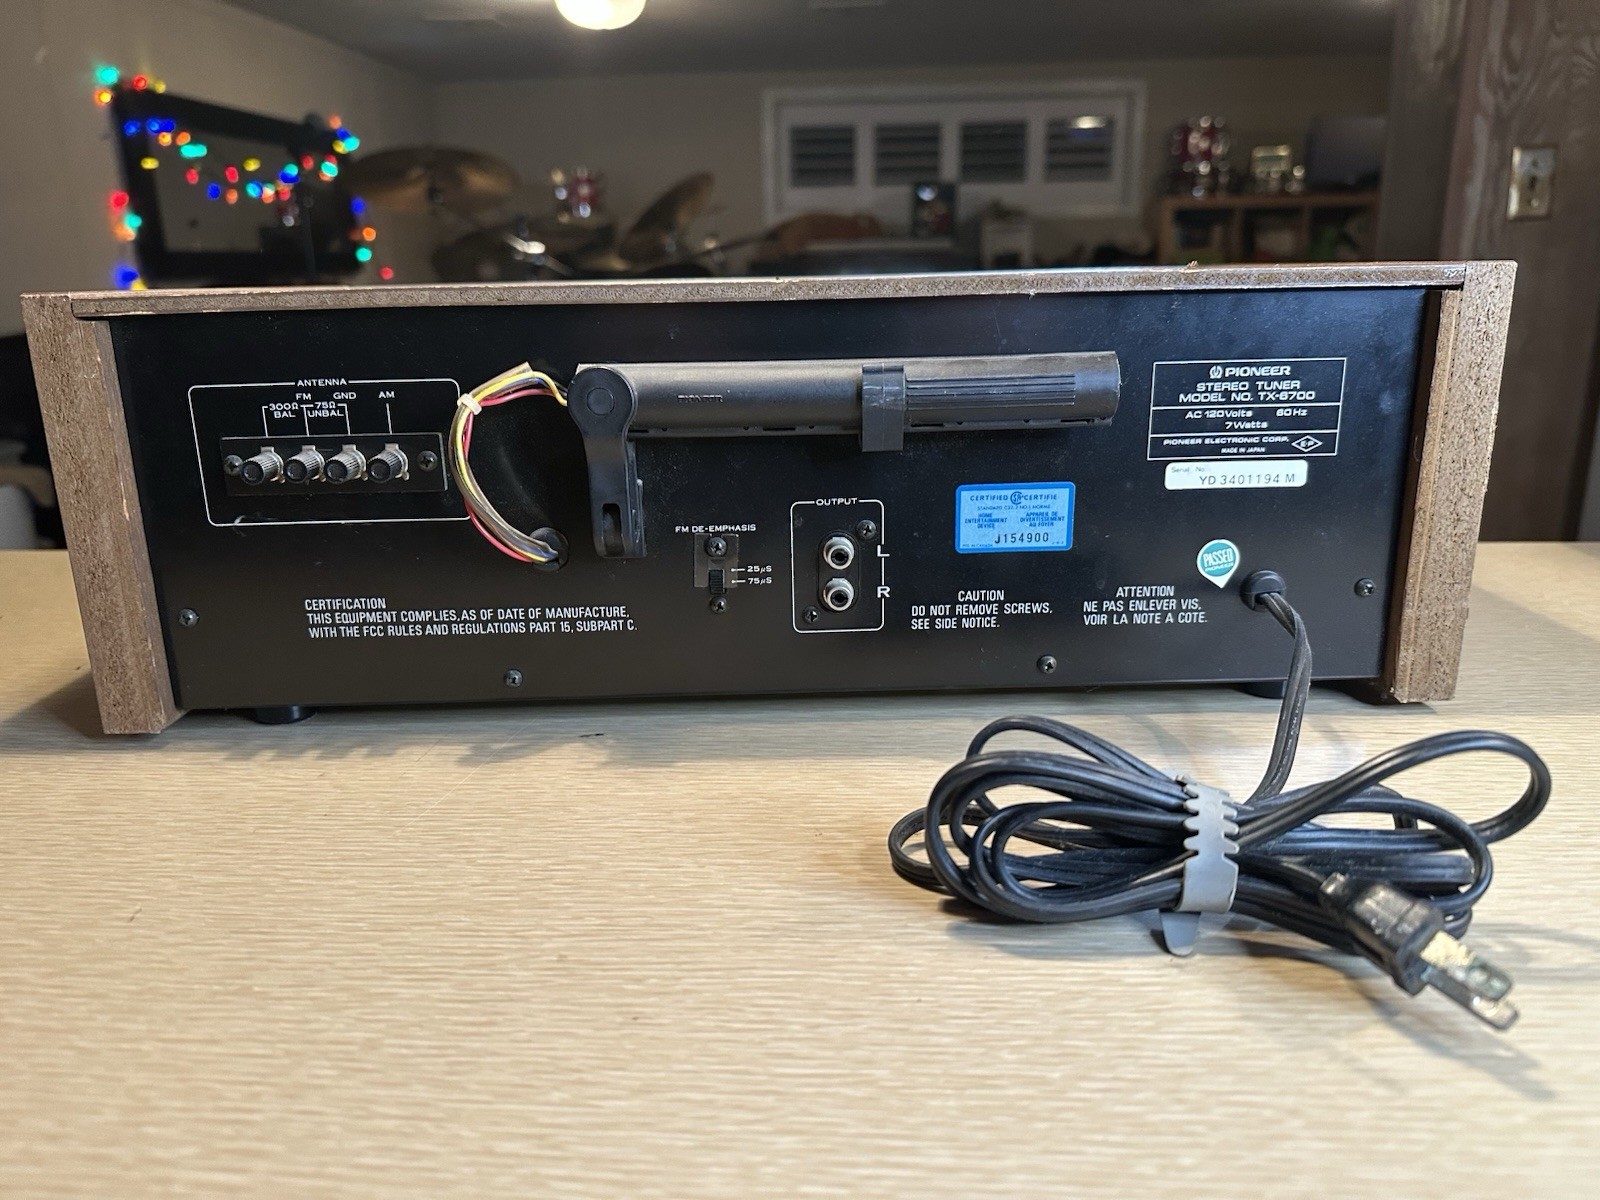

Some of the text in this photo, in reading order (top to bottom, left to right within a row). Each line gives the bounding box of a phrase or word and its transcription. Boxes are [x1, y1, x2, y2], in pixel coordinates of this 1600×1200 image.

[1224, 366, 1291, 378] PIONEER
[297, 378, 348, 387] ANTENNA
[1196, 380, 1301, 392] STEREO TUNER
[295, 392, 312, 400] FM
[333, 392, 357, 400] GND
[378, 390, 395, 399] AM
[1178, 392, 1226, 403] MODEL
[1230, 392, 1254, 402] NO.
[269, 402, 299, 411] 300Ω
[314, 401, 336, 410] 75Ω
[273, 410, 296, 418] BAL
[307, 410, 345, 418] UNBAL
[1185, 411, 1202, 420] AC
[1163, 438, 1202, 446] PIONEER
[1204, 436, 1260, 445] ELECTRONIC
[1221, 446, 1266, 454] MADE IN JAPAN
[1199, 472, 1296, 486] YD 3401194 M
[816, 498, 858, 506] OUTPUT
[970, 494, 1008, 502] CERTIFIED
[692, 524, 757, 533] DE-EMPHASIS
[994, 532, 1050, 545] J154900
[876, 544, 890, 558] L
[1203, 548, 1234, 568] PASSED
[876, 586, 891, 598] R
[958, 590, 1005, 602] CAUTION
[1116, 586, 1175, 598] ATTENTION
[304, 598, 386, 610] CERTIFICATION
[912, 605, 926, 616] DO
[930, 604, 951, 616] NOT
[956, 603, 999, 616] REMOVE
[1083, 600, 1098, 612] NE
[1102, 600, 1124, 612] PAS
[1129, 599, 1176, 612] ENLEVER
[306, 612, 332, 624] THIS
[335, 611, 398, 624] EQUIPMENT
[480, 608, 494, 620] OF
[498, 608, 525, 620] DATE
[528, 608, 542, 620] OF
[1084, 612, 1208, 626] VOIR LA NOTE A COTE.
[308, 626, 338, 638] WITH
[339, 626, 360, 638] THE
[362, 625, 384, 637] FCC
[388, 624, 423, 636] RULES
[425, 624, 449, 636] AND
[452, 622, 526, 635] REGULATIONS
[530, 622, 556, 633] PART
[576, 620, 624, 632] SUBPART
[626, 620, 638, 631] C.
[911, 616, 1000, 630] SEE SIDE NOTICE.
